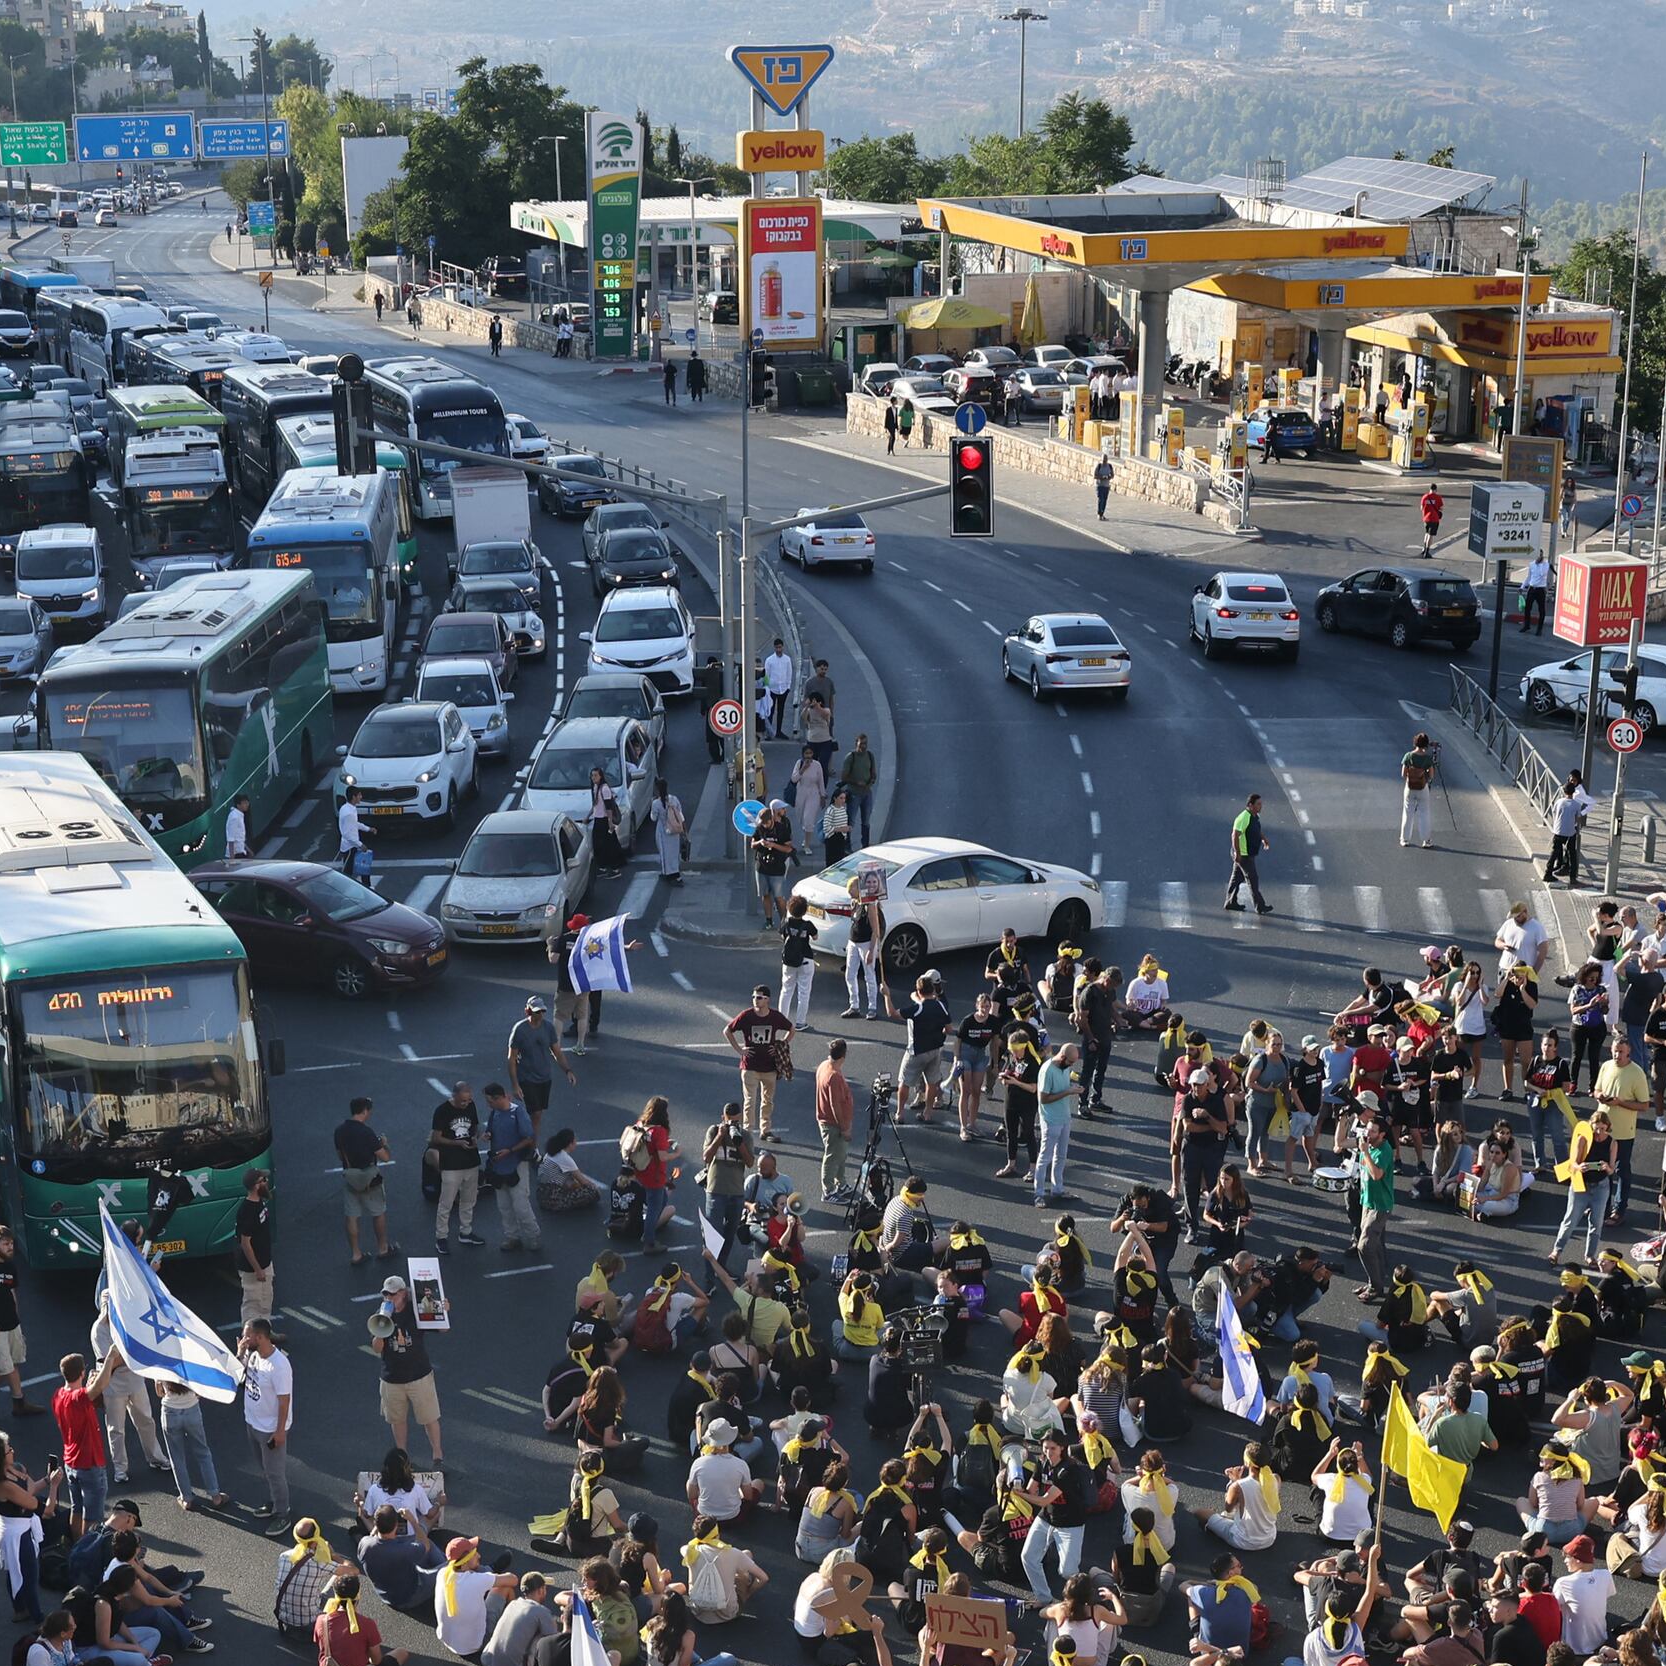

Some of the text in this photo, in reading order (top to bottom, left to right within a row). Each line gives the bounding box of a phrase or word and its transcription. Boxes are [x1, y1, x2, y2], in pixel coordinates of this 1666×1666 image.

[763, 56, 802, 84] פז
[207, 144, 265, 153] Begin Blvd North
[750, 141, 817, 163] yellow
[595, 160, 636, 170] דור אלון
[600, 194, 629, 203] אלונית
[758, 217, 809, 229] כפית כורכום
[765, 230, 802, 243] בבקבוק!
[1040, 234, 1069, 255] yellow
[1323, 230, 1387, 253] yellow
[1119, 238, 1148, 261] פז
[1318, 283, 1346, 305] פז
[1526, 326, 1598, 355] yellow
[433, 408, 488, 418] MILLENNIUM TOURS
[1493, 510, 1519, 522] מלכות
[1521, 511, 1539, 520] שיש
[275, 553, 290, 567] 615
[1563, 561, 1582, 606] MAX
[1599, 571, 1635, 609] MAX
[718, 710, 738, 726] 30
[1614, 728, 1635, 744] 30
[49, 991, 82, 1010] 470
